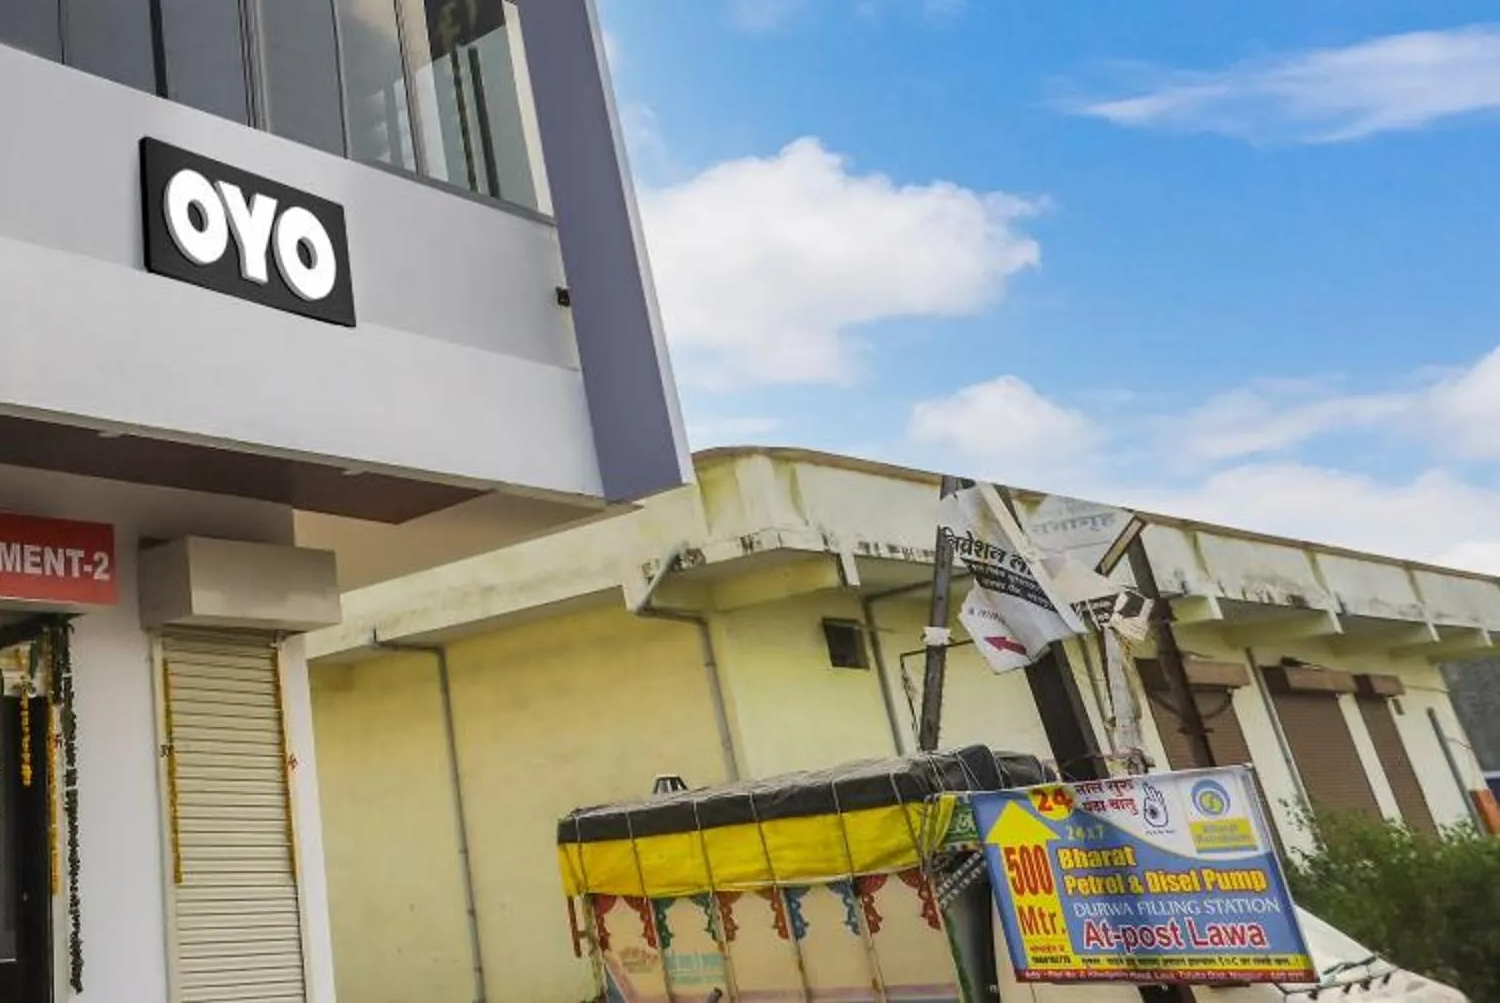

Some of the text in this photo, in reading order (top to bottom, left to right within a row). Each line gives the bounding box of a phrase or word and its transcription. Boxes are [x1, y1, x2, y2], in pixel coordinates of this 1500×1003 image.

[164, 169, 336, 301] OYO
[1003, 844, 1053, 896] 500
[1057, 846, 1137, 870] Bharat
[1063, 868, 1268, 895] Petrol & Disel Pump
[1017, 905, 1066, 936] Mtr.
[1073, 897, 1281, 917] DURWA FILLING STATION
[1083, 916, 1269, 953] At-post Lawa
